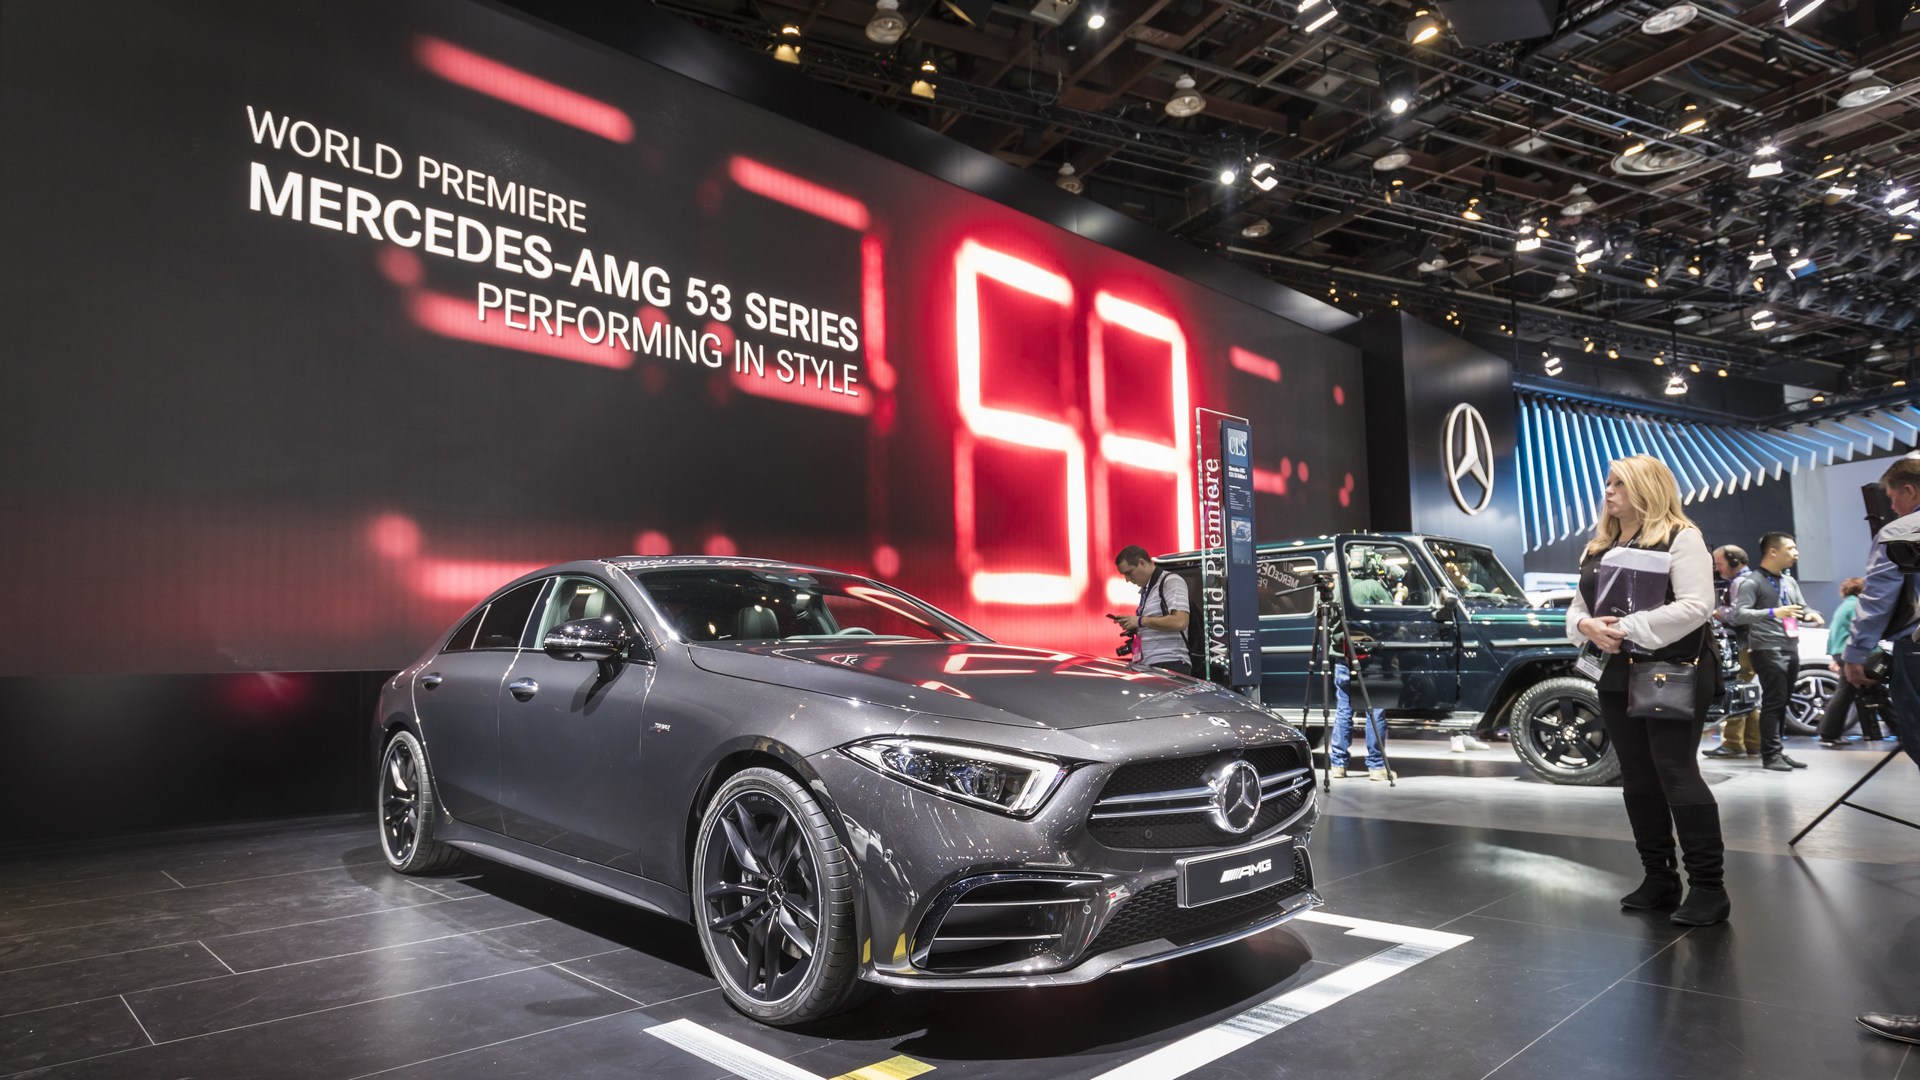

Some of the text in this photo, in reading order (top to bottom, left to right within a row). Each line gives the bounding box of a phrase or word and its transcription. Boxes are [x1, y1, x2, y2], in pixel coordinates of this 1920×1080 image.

[246, 105, 587, 234] WORLD PREMIERE
[249, 161, 859, 352] MERCEDES-AMG 53 SERIES
[477, 282, 859, 396] PERFORMING IN STYLE
[1228, 436, 1247, 457] CLS
[1205, 458, 1226, 664] World Premiere
[1237, 858, 1272, 879] AMG
